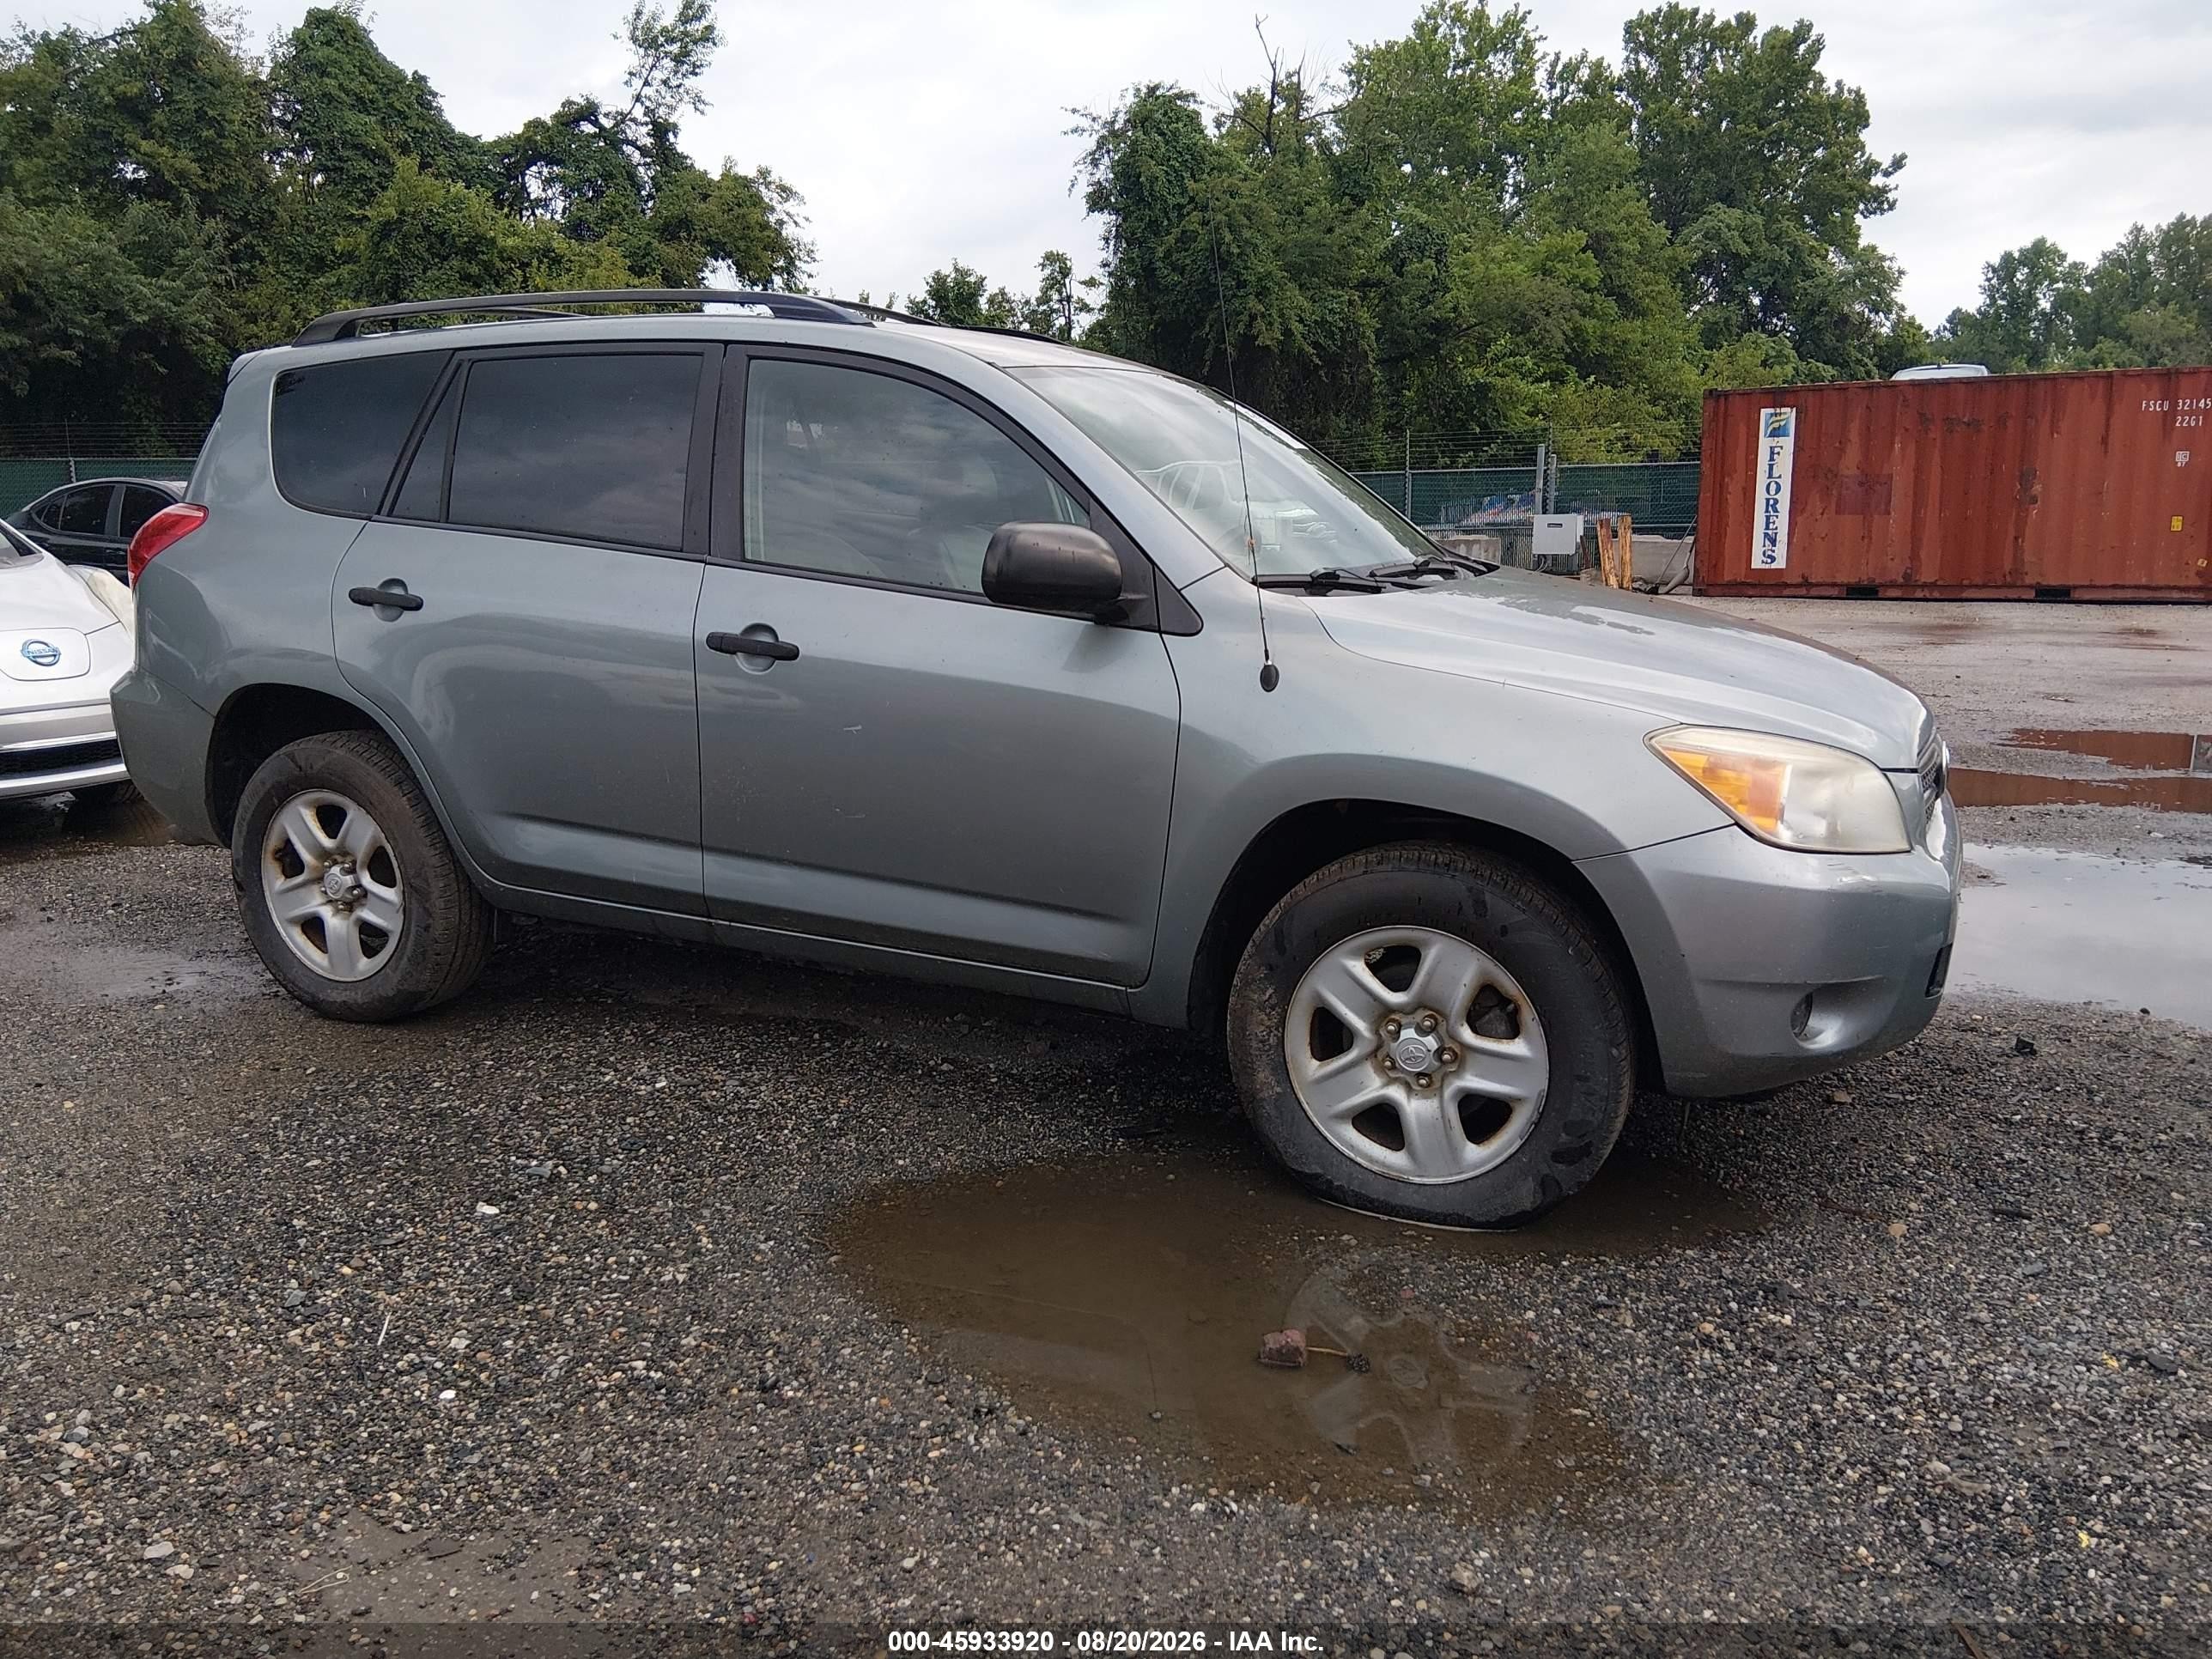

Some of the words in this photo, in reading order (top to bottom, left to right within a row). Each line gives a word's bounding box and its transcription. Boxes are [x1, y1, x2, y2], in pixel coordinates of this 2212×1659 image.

[2142, 400, 2169, 411] FSCU
[2175, 416, 2203, 427] 22G1
[1761, 446, 1784, 565] FLORENS
